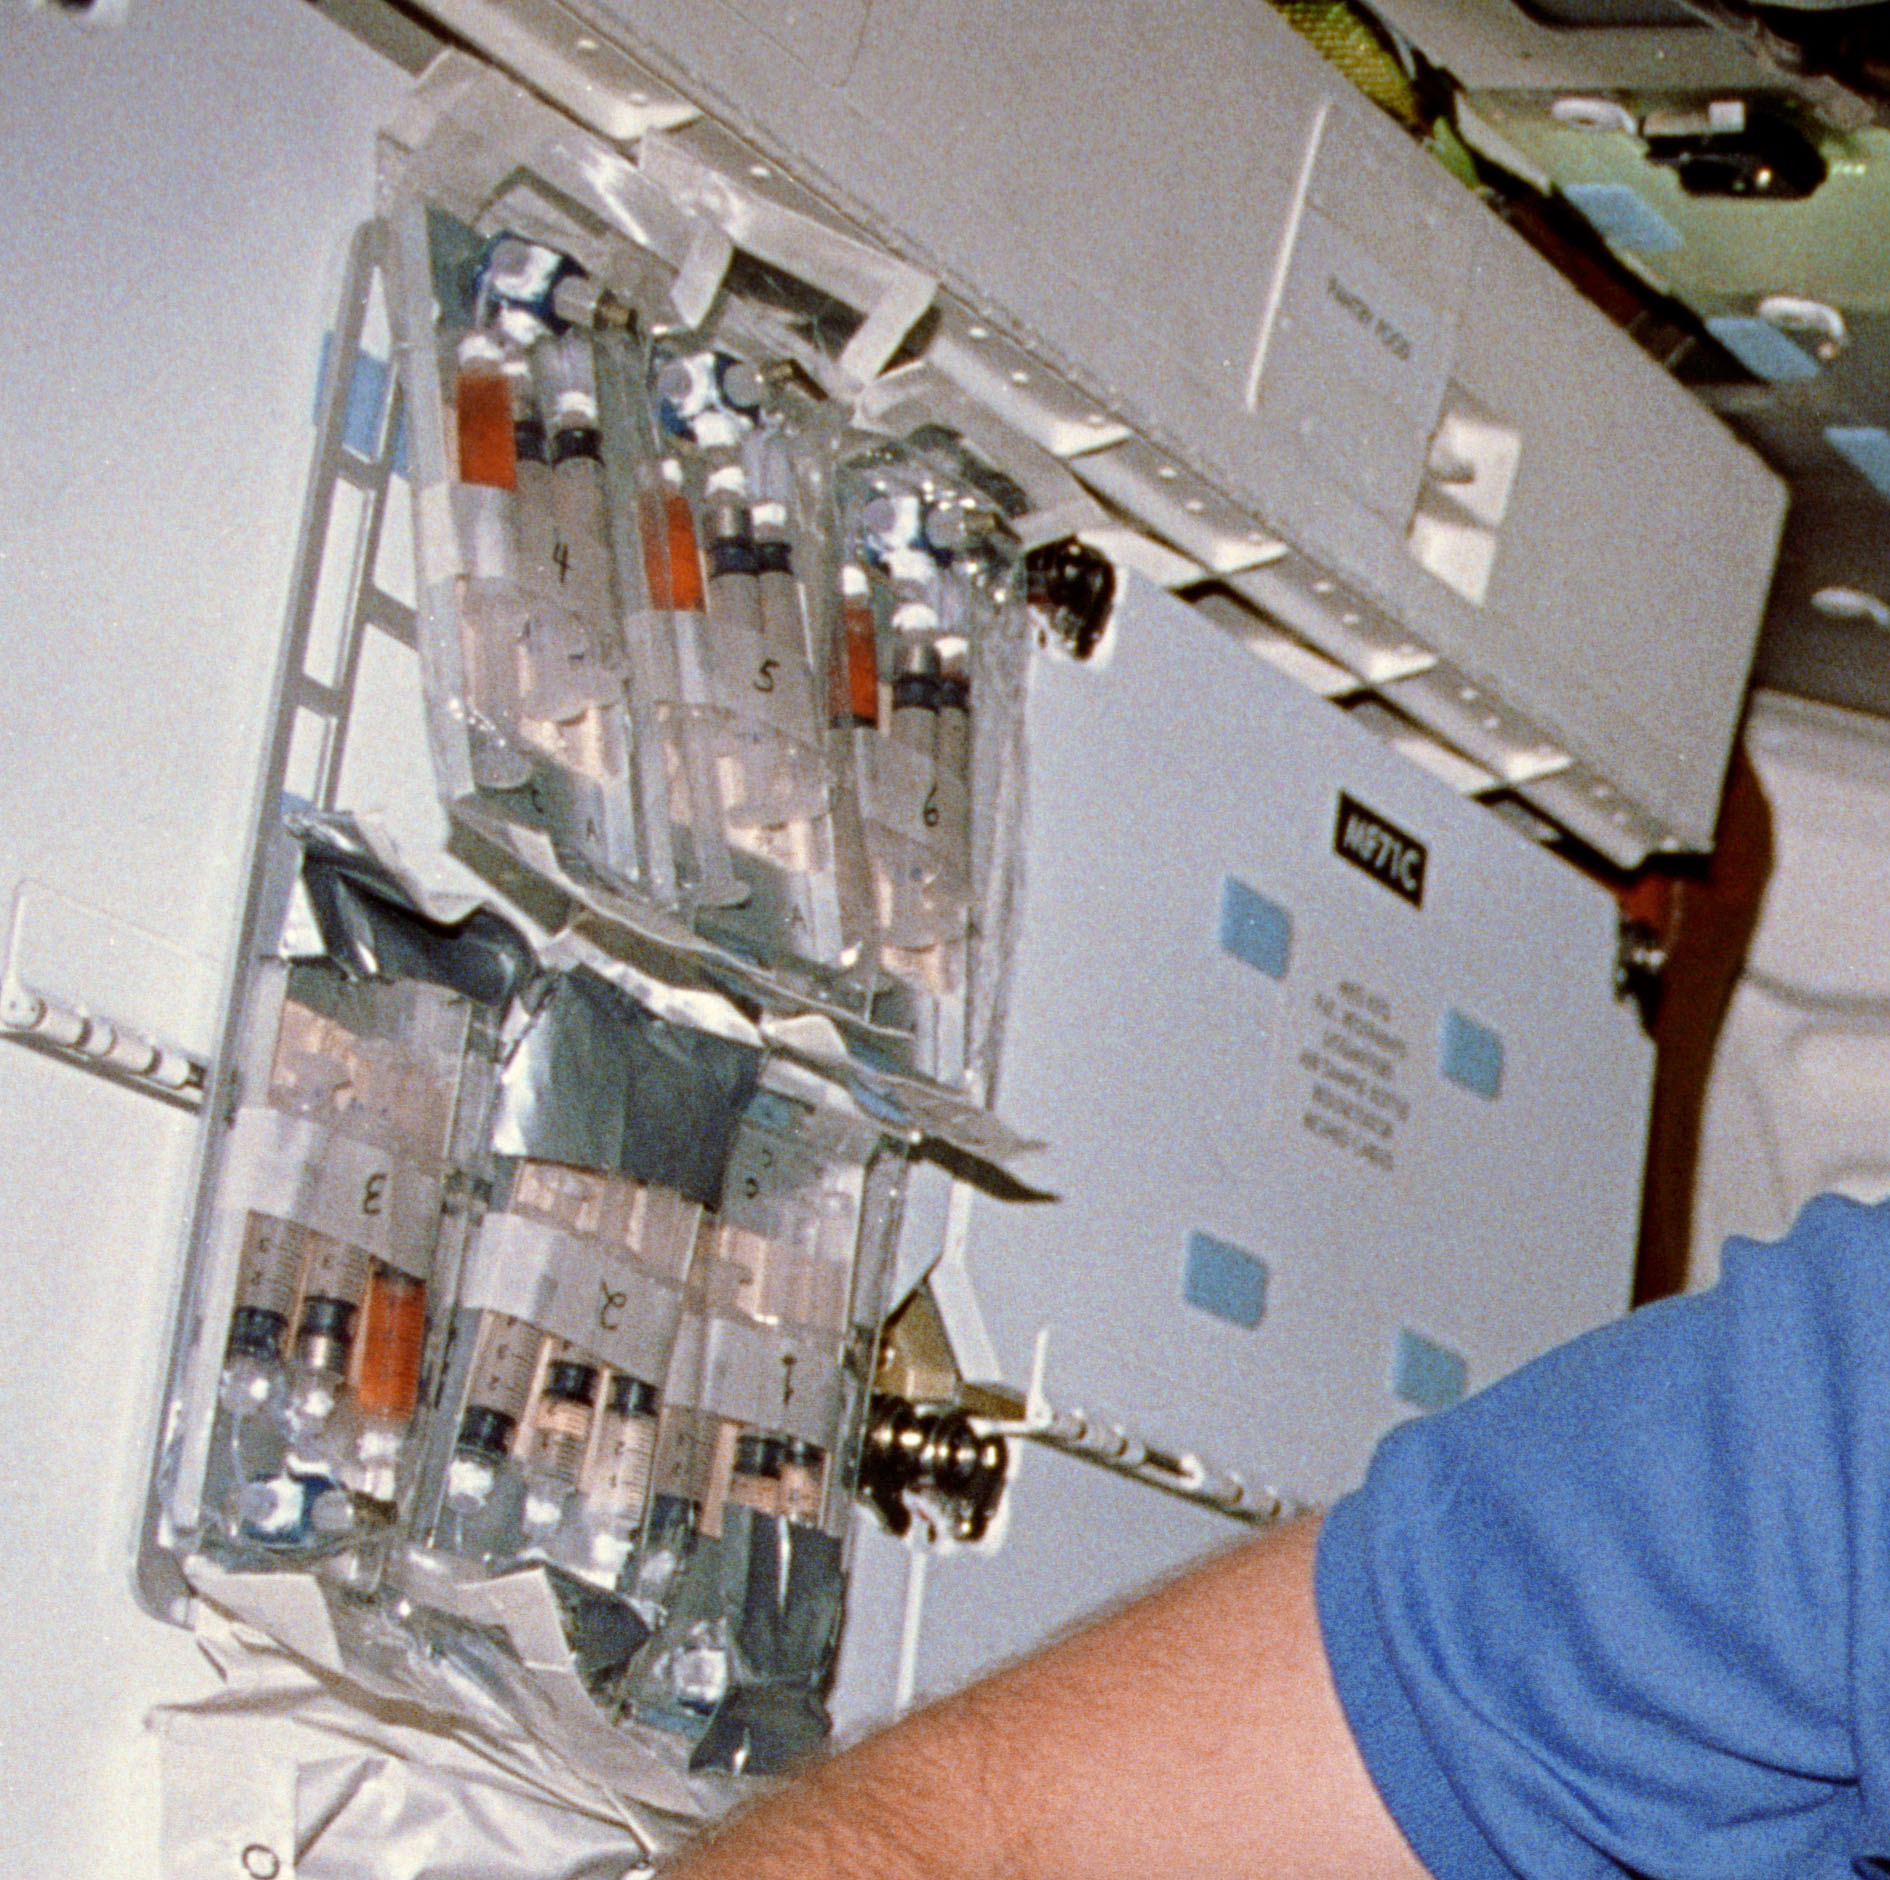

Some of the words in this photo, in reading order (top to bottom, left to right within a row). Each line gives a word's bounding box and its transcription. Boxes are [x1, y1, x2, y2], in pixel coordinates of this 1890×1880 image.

[552, 541, 573, 584] 4
[752, 658, 780, 692] 5
[922, 783, 941, 827] 6
[1343, 813, 1421, 892] MF71C
